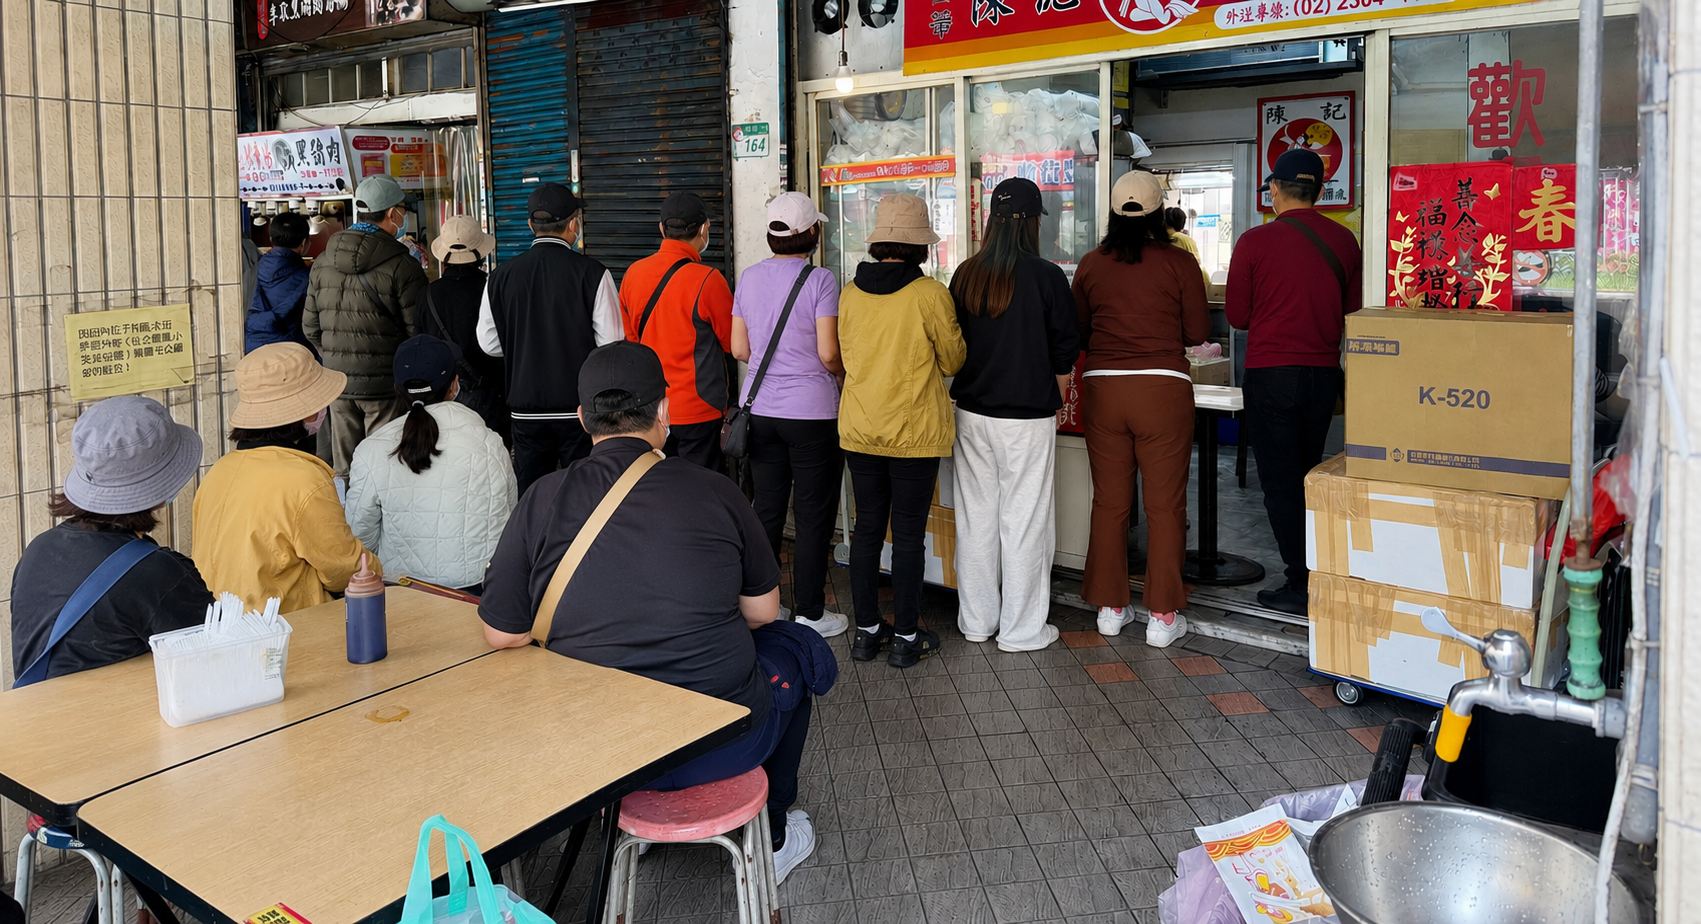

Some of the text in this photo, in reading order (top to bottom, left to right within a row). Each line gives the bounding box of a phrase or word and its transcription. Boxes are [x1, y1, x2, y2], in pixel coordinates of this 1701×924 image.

[1467, 59, 1546, 149] 歡
[745, 137, 766, 153] 164
[1515, 178, 1577, 244] 春
[1419, 386, 1491, 410] K-520
